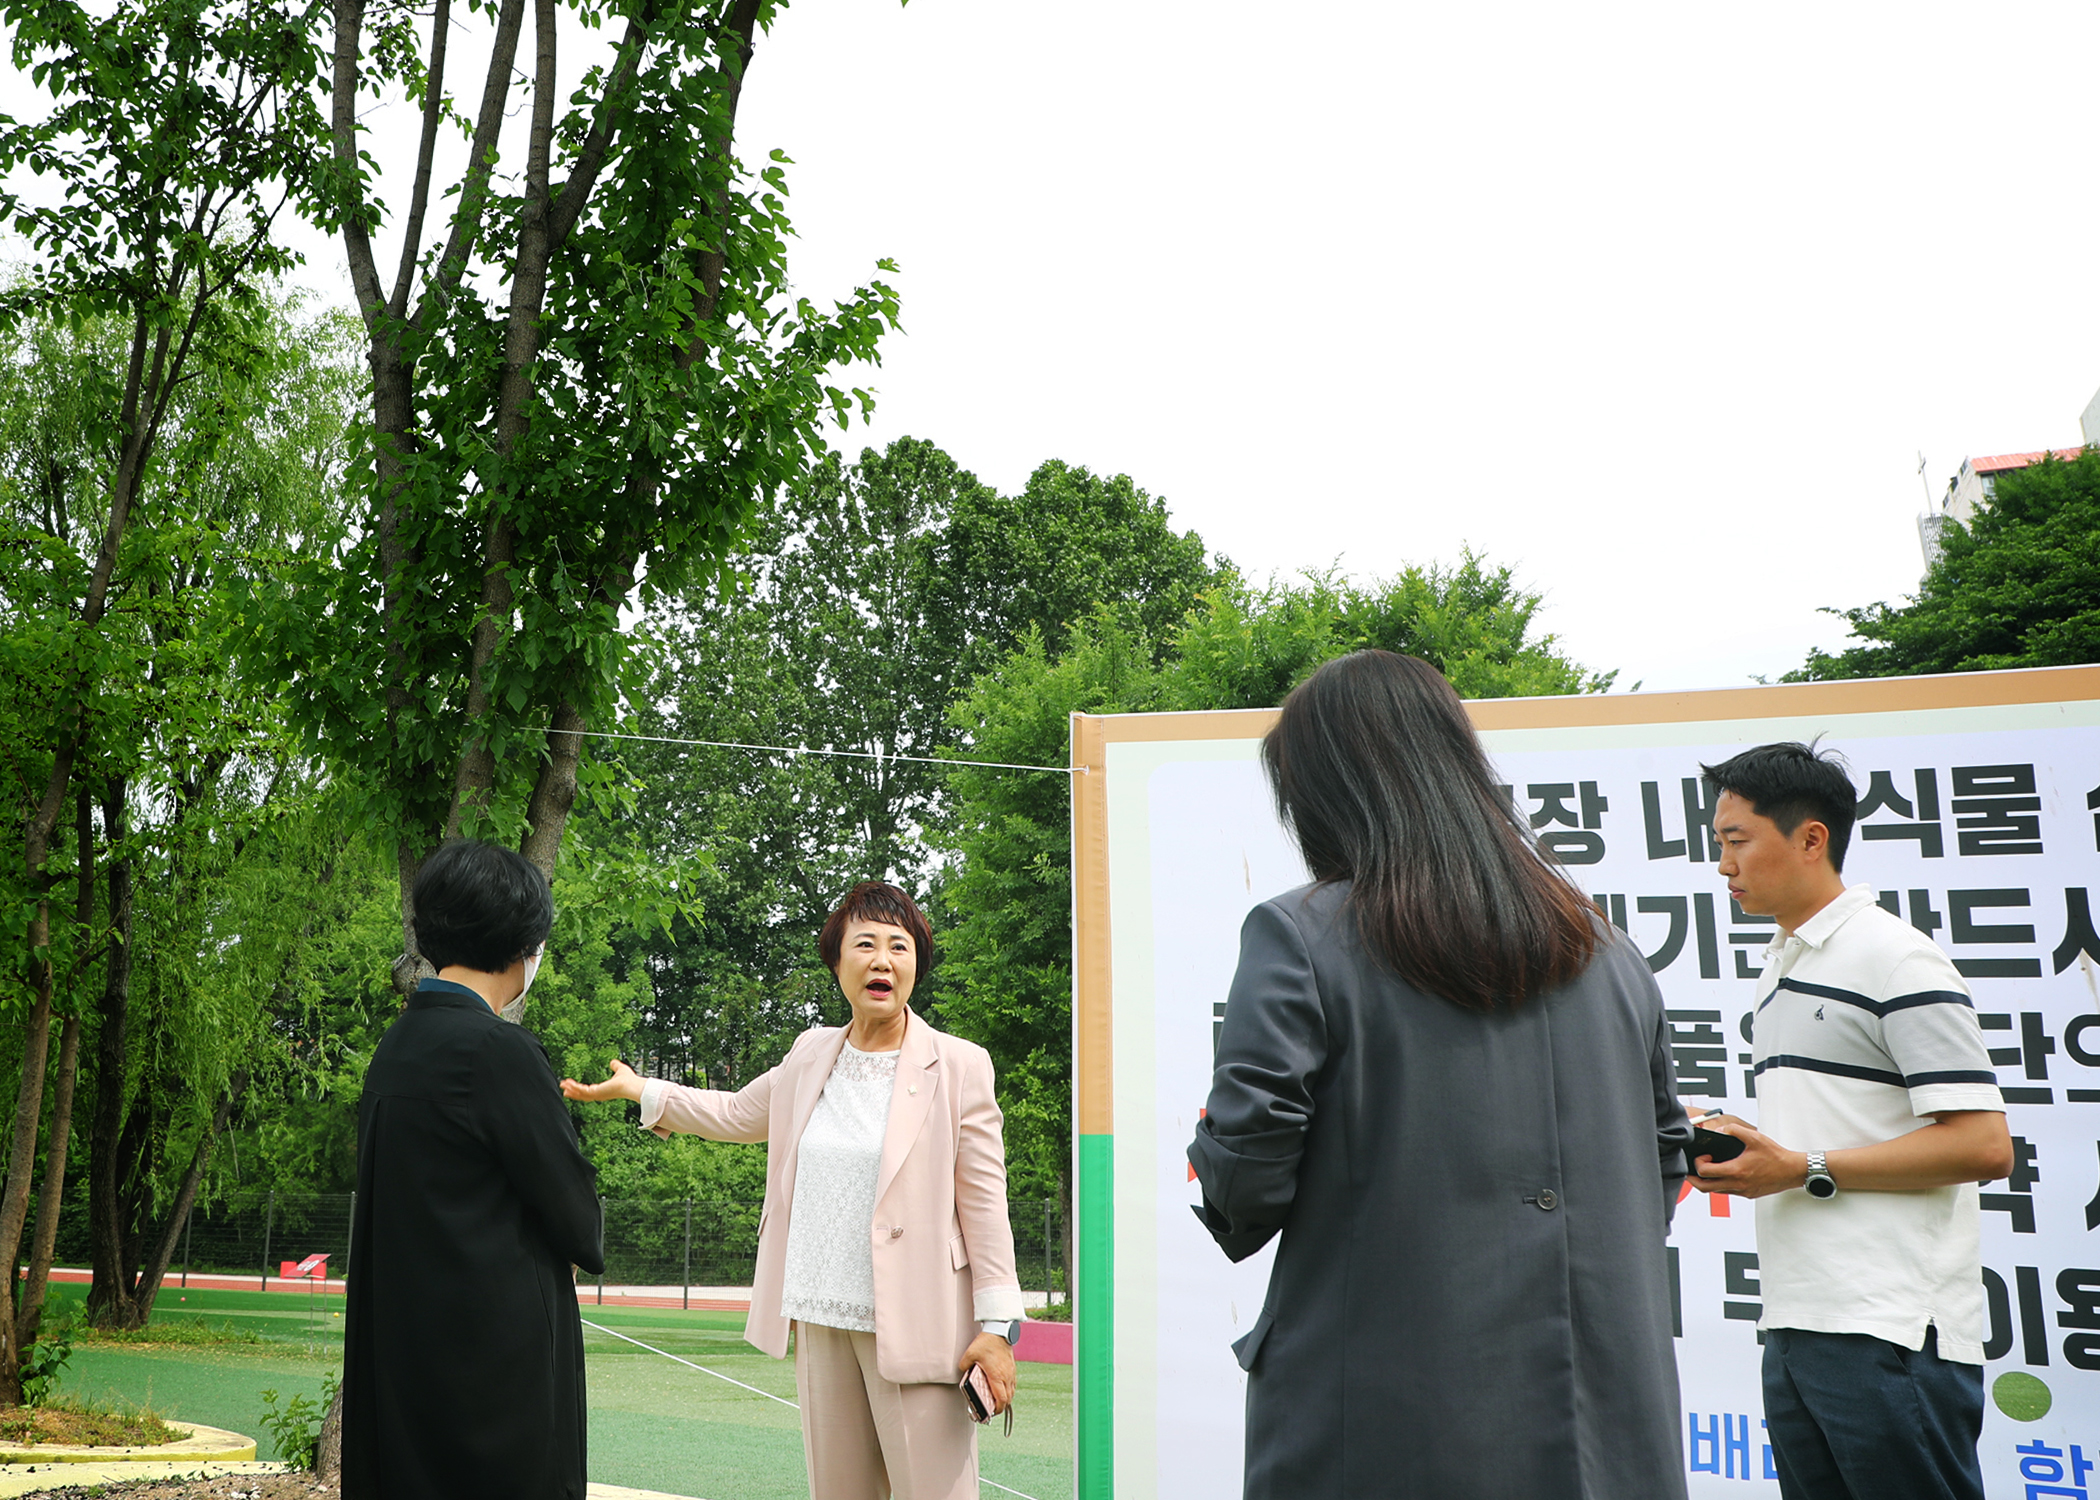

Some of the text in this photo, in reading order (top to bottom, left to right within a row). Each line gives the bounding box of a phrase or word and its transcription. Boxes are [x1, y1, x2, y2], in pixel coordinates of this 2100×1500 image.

[1493, 777, 1609, 865] 장
[1640, 777, 1720, 863] 내
[1689, 1412, 1779, 1481] 배
